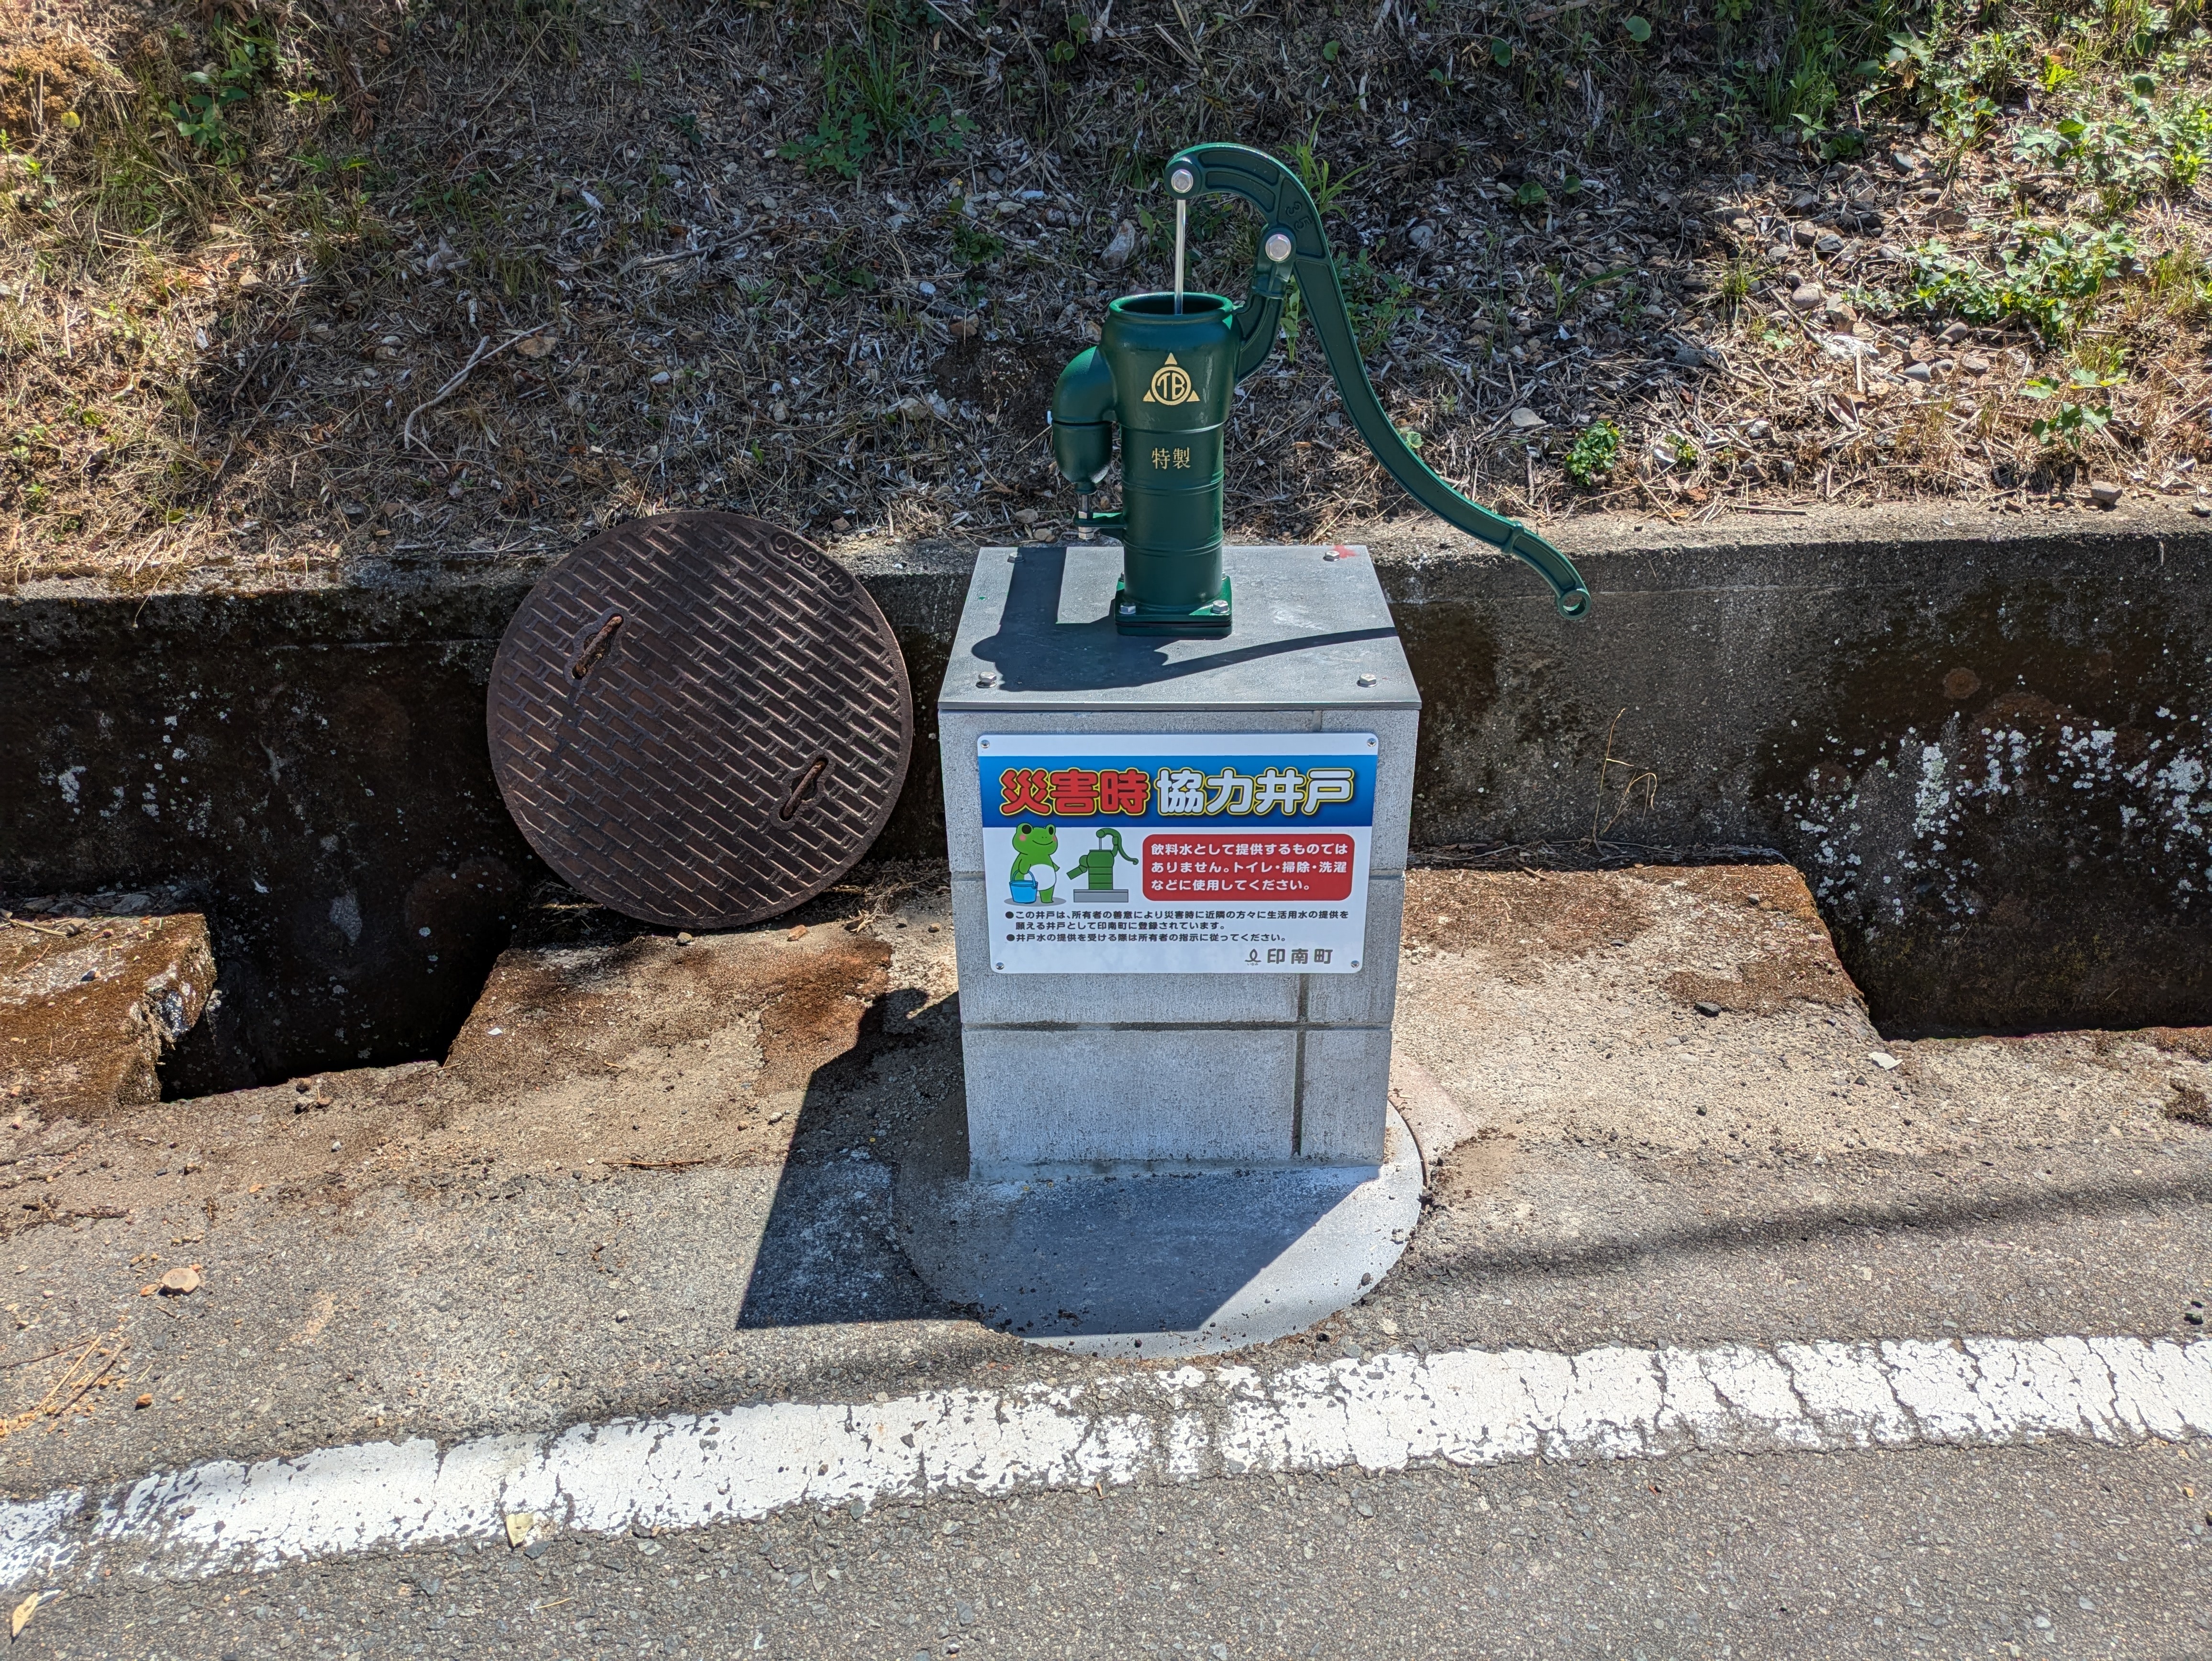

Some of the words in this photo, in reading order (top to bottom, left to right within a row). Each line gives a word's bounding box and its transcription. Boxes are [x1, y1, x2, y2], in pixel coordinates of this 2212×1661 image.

[1286, 201, 1312, 231] 35
[1151, 447, 1191, 470] 特製
[1000, 767, 1150, 816] 災害時
[1154, 767, 1354, 816] 協力井戸
[1150, 843, 1349, 856] 飲料水として提供するものでは
[1150, 861, 1348, 874] ありません。トイレ・掃除・洗濯
[1151, 879, 1310, 891] などに使用してください。
[1015, 910, 1349, 919] この井戸は、所有者の善意により災害時に近隣の方々に生活用水の提供を
[1015, 921, 1225, 930] 願える井戸として印南町に登録されています。
[1016, 933, 1286, 942] 井戸水の提供を受ける際は所有者の指示に従ってください。
[1267, 948, 1333, 964] 印南町
